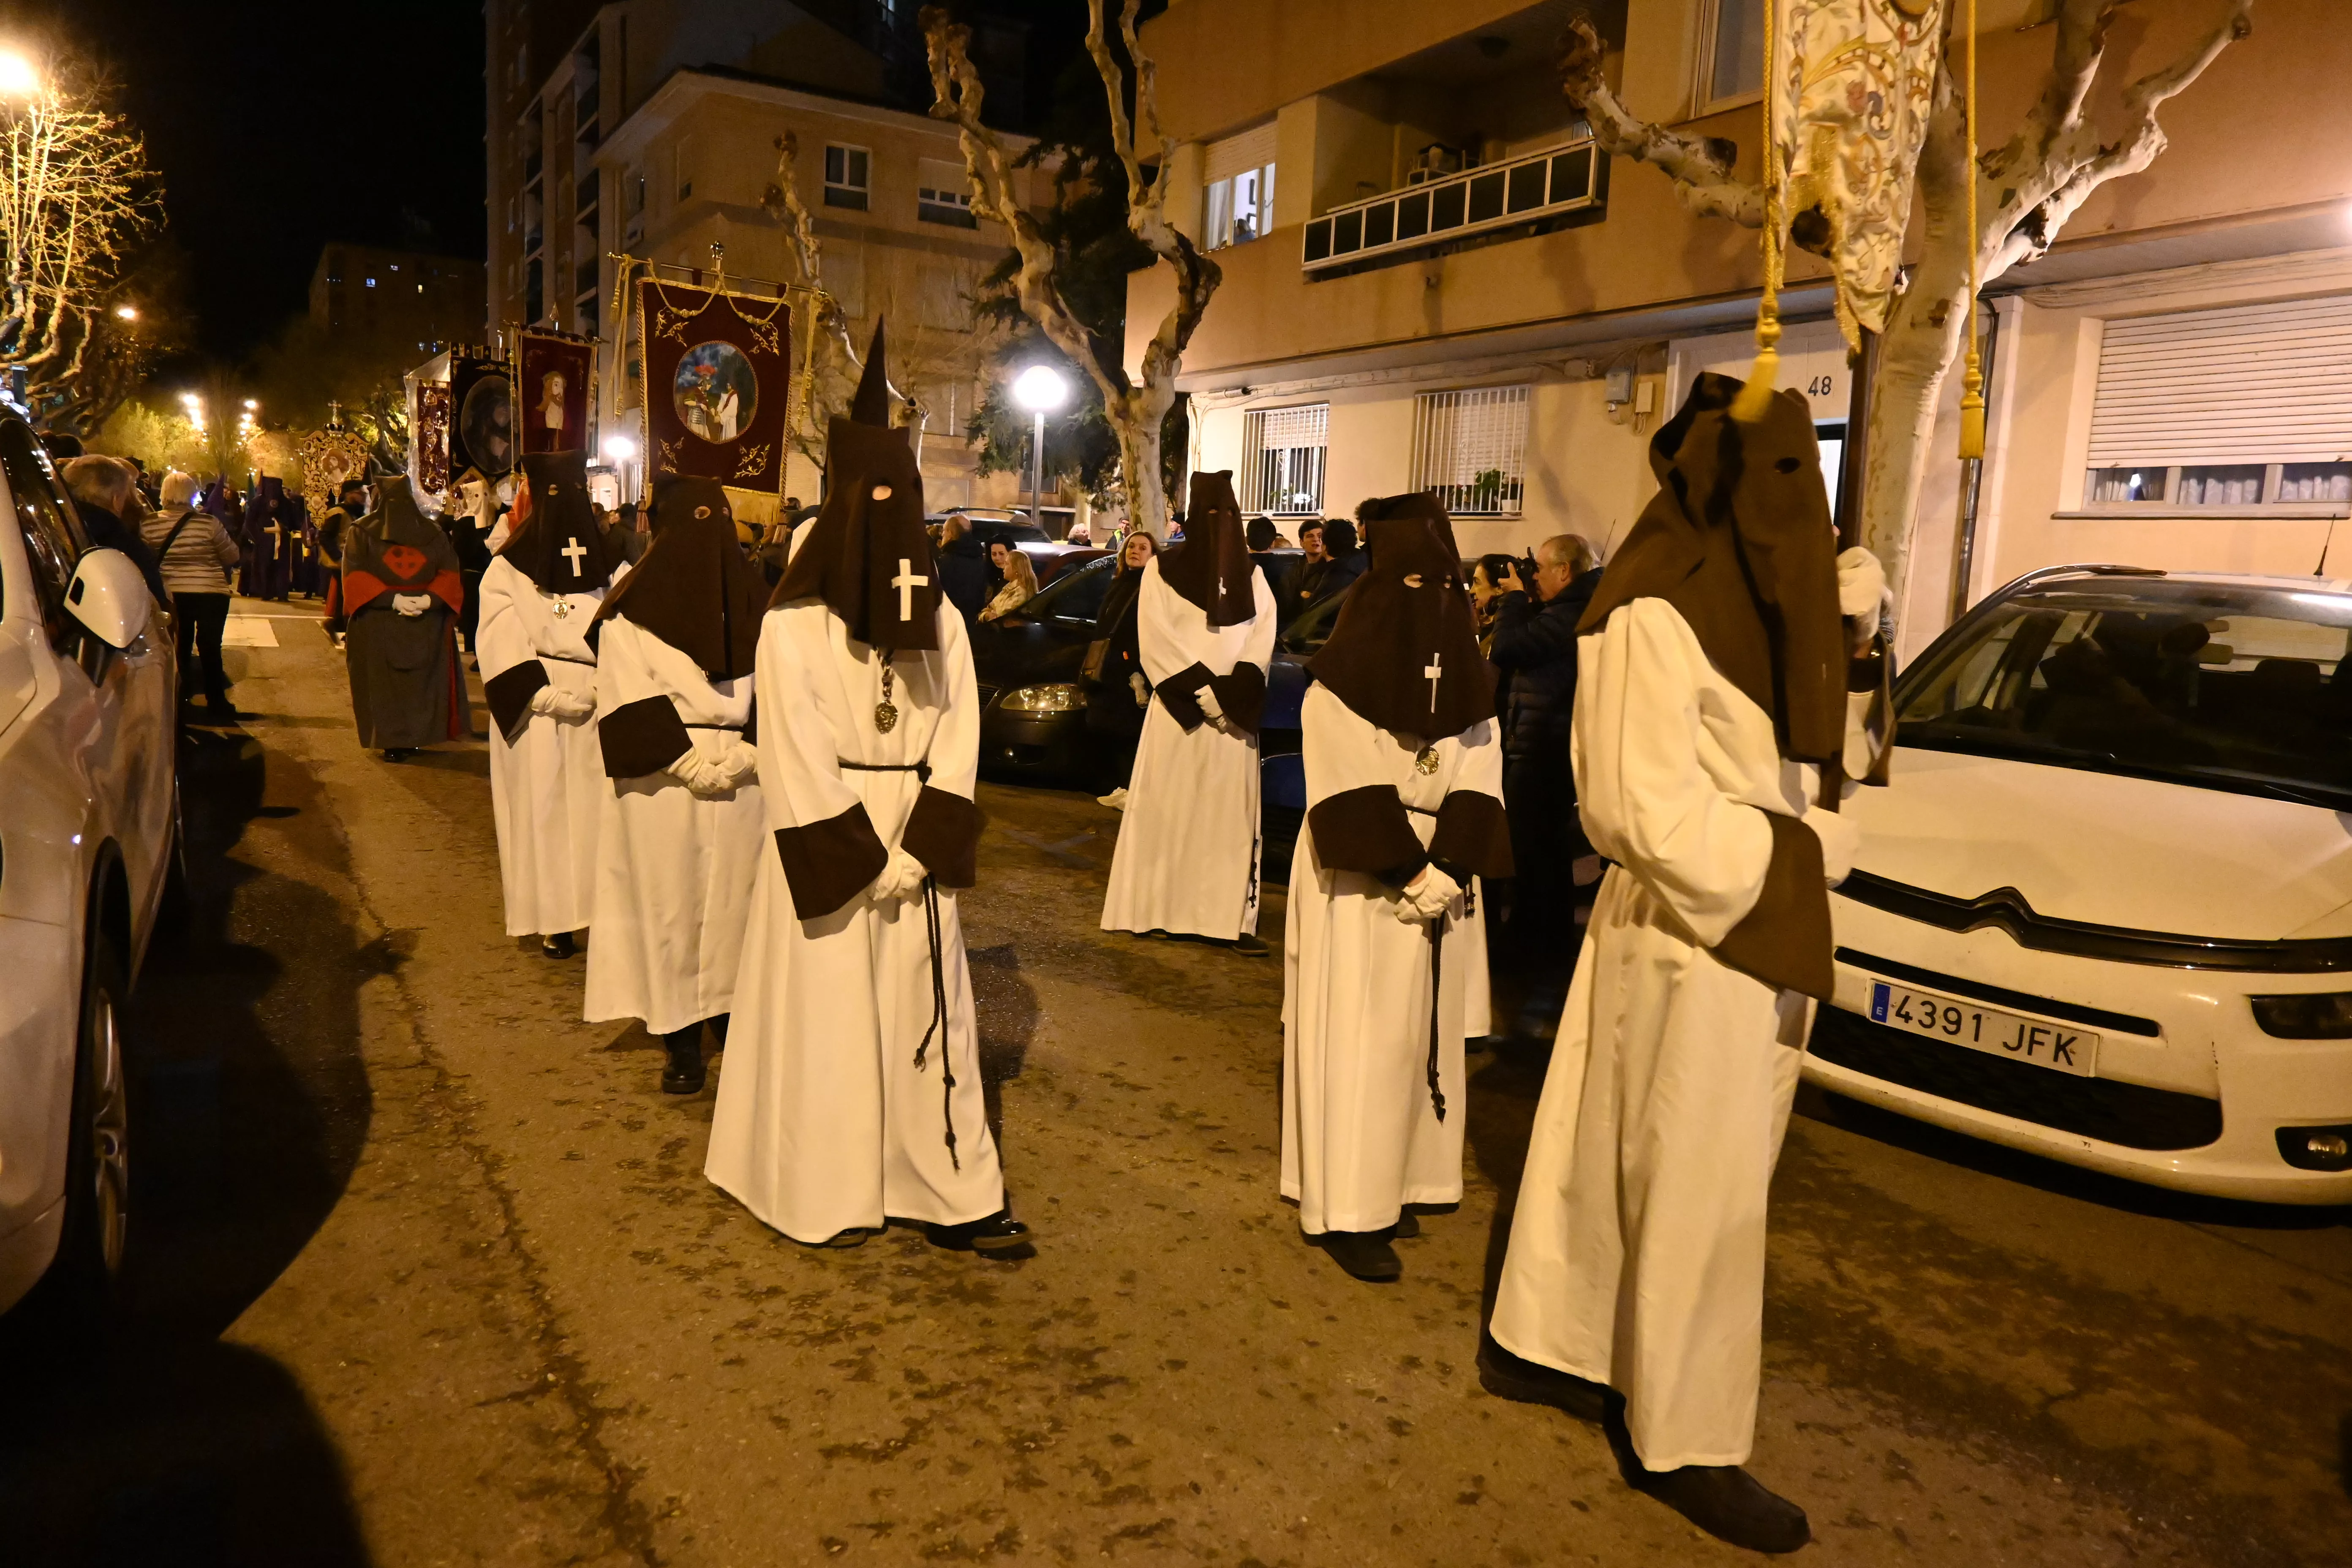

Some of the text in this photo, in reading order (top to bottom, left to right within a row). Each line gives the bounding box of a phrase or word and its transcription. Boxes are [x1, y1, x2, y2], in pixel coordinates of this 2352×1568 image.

[1808, 376, 1832, 396] 48
[1876, 1007, 1883, 1015] E
[1895, 995, 2077, 1067] 4391 JFK
